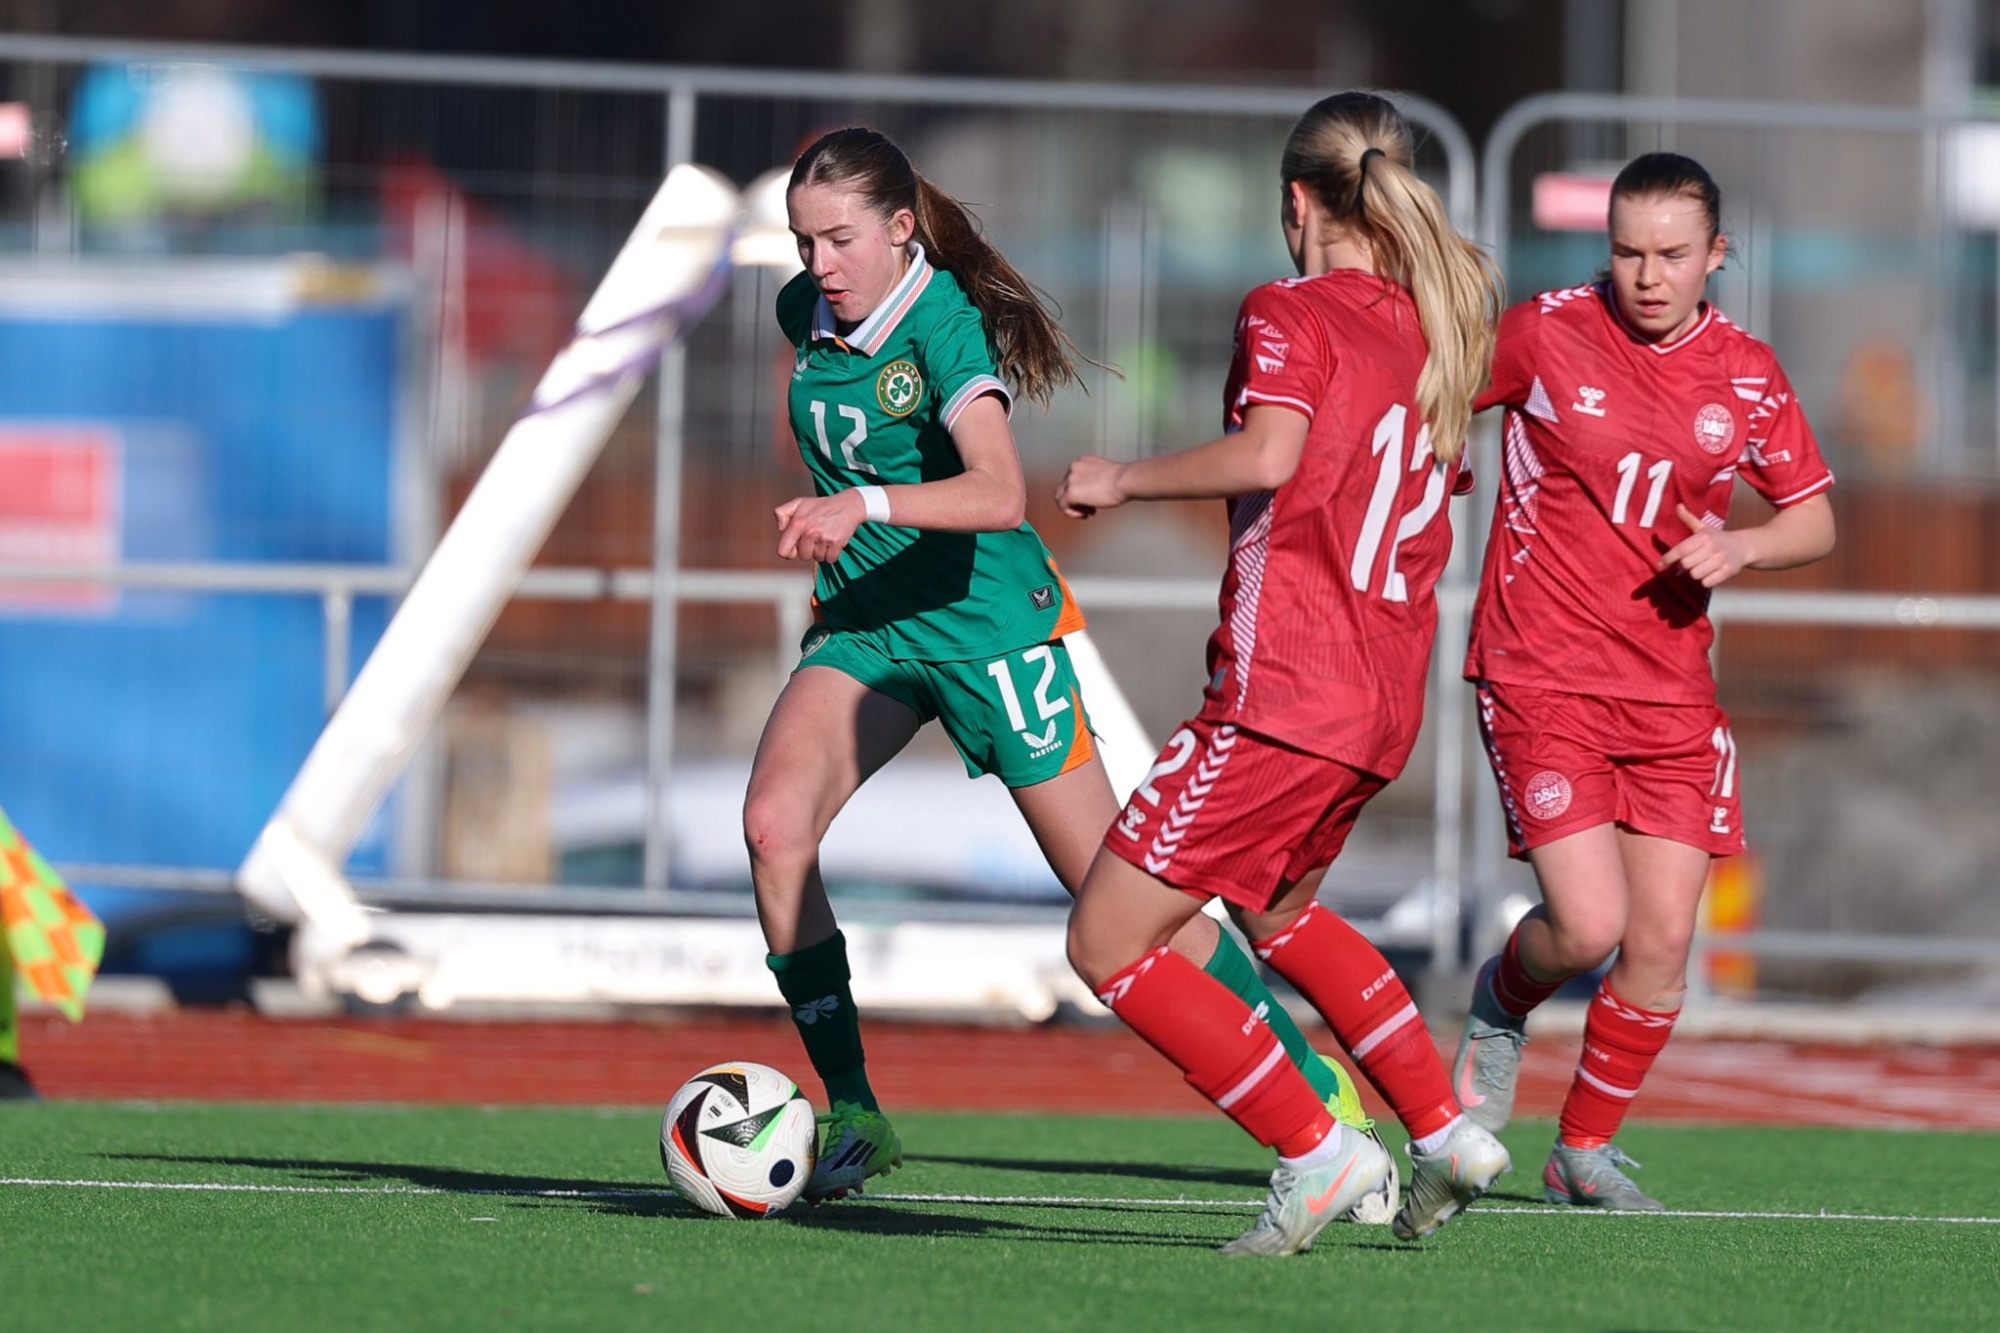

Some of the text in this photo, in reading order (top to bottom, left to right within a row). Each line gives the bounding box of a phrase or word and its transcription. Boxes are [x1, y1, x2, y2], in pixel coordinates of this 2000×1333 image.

[882, 364, 919, 383] IRELAND
[809, 400, 878, 475] 12
[1350, 402, 1449, 604] 12
[1611, 452, 1674, 528] 11
[987, 644, 1071, 733] 12
